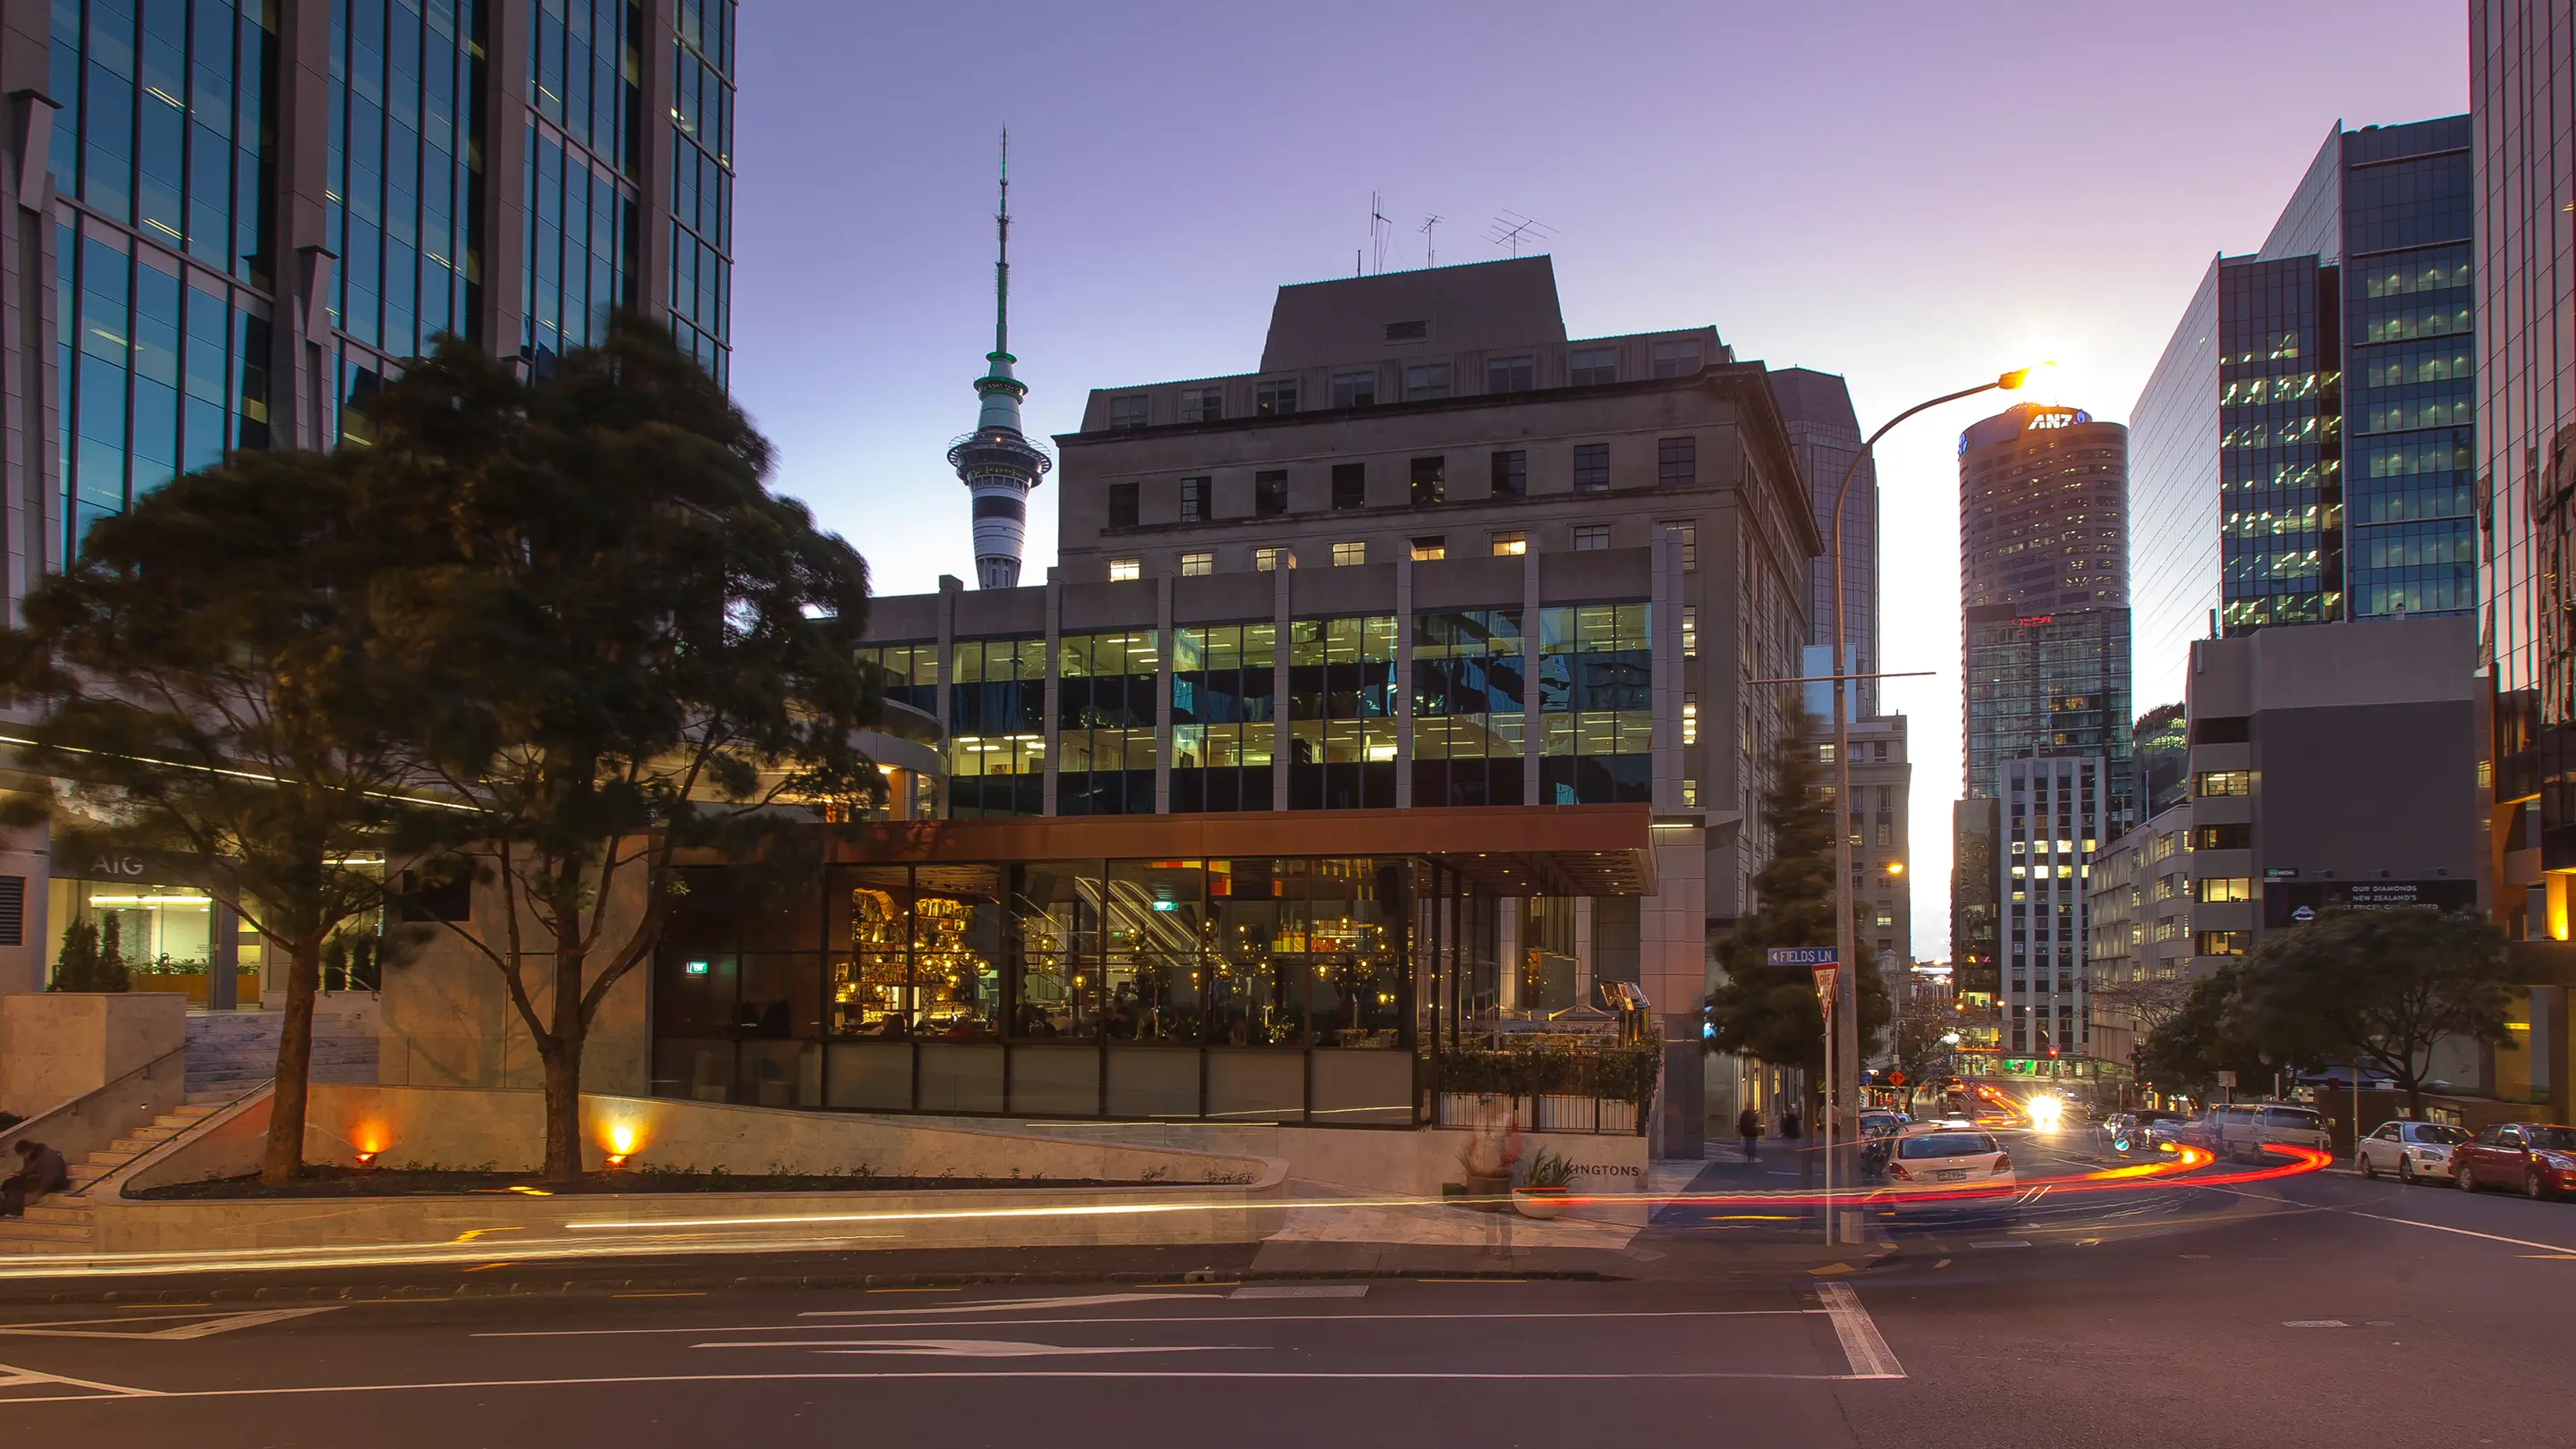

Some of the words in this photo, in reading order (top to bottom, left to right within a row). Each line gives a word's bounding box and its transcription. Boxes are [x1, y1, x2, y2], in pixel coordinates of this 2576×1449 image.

[2027, 413, 2073, 430] ANZ
[89, 854, 144, 876] AIG
[1780, 951, 1815, 962] FIELDS
[1818, 951, 1832, 962] LN
[1820, 974, 1831, 986] GIVE
